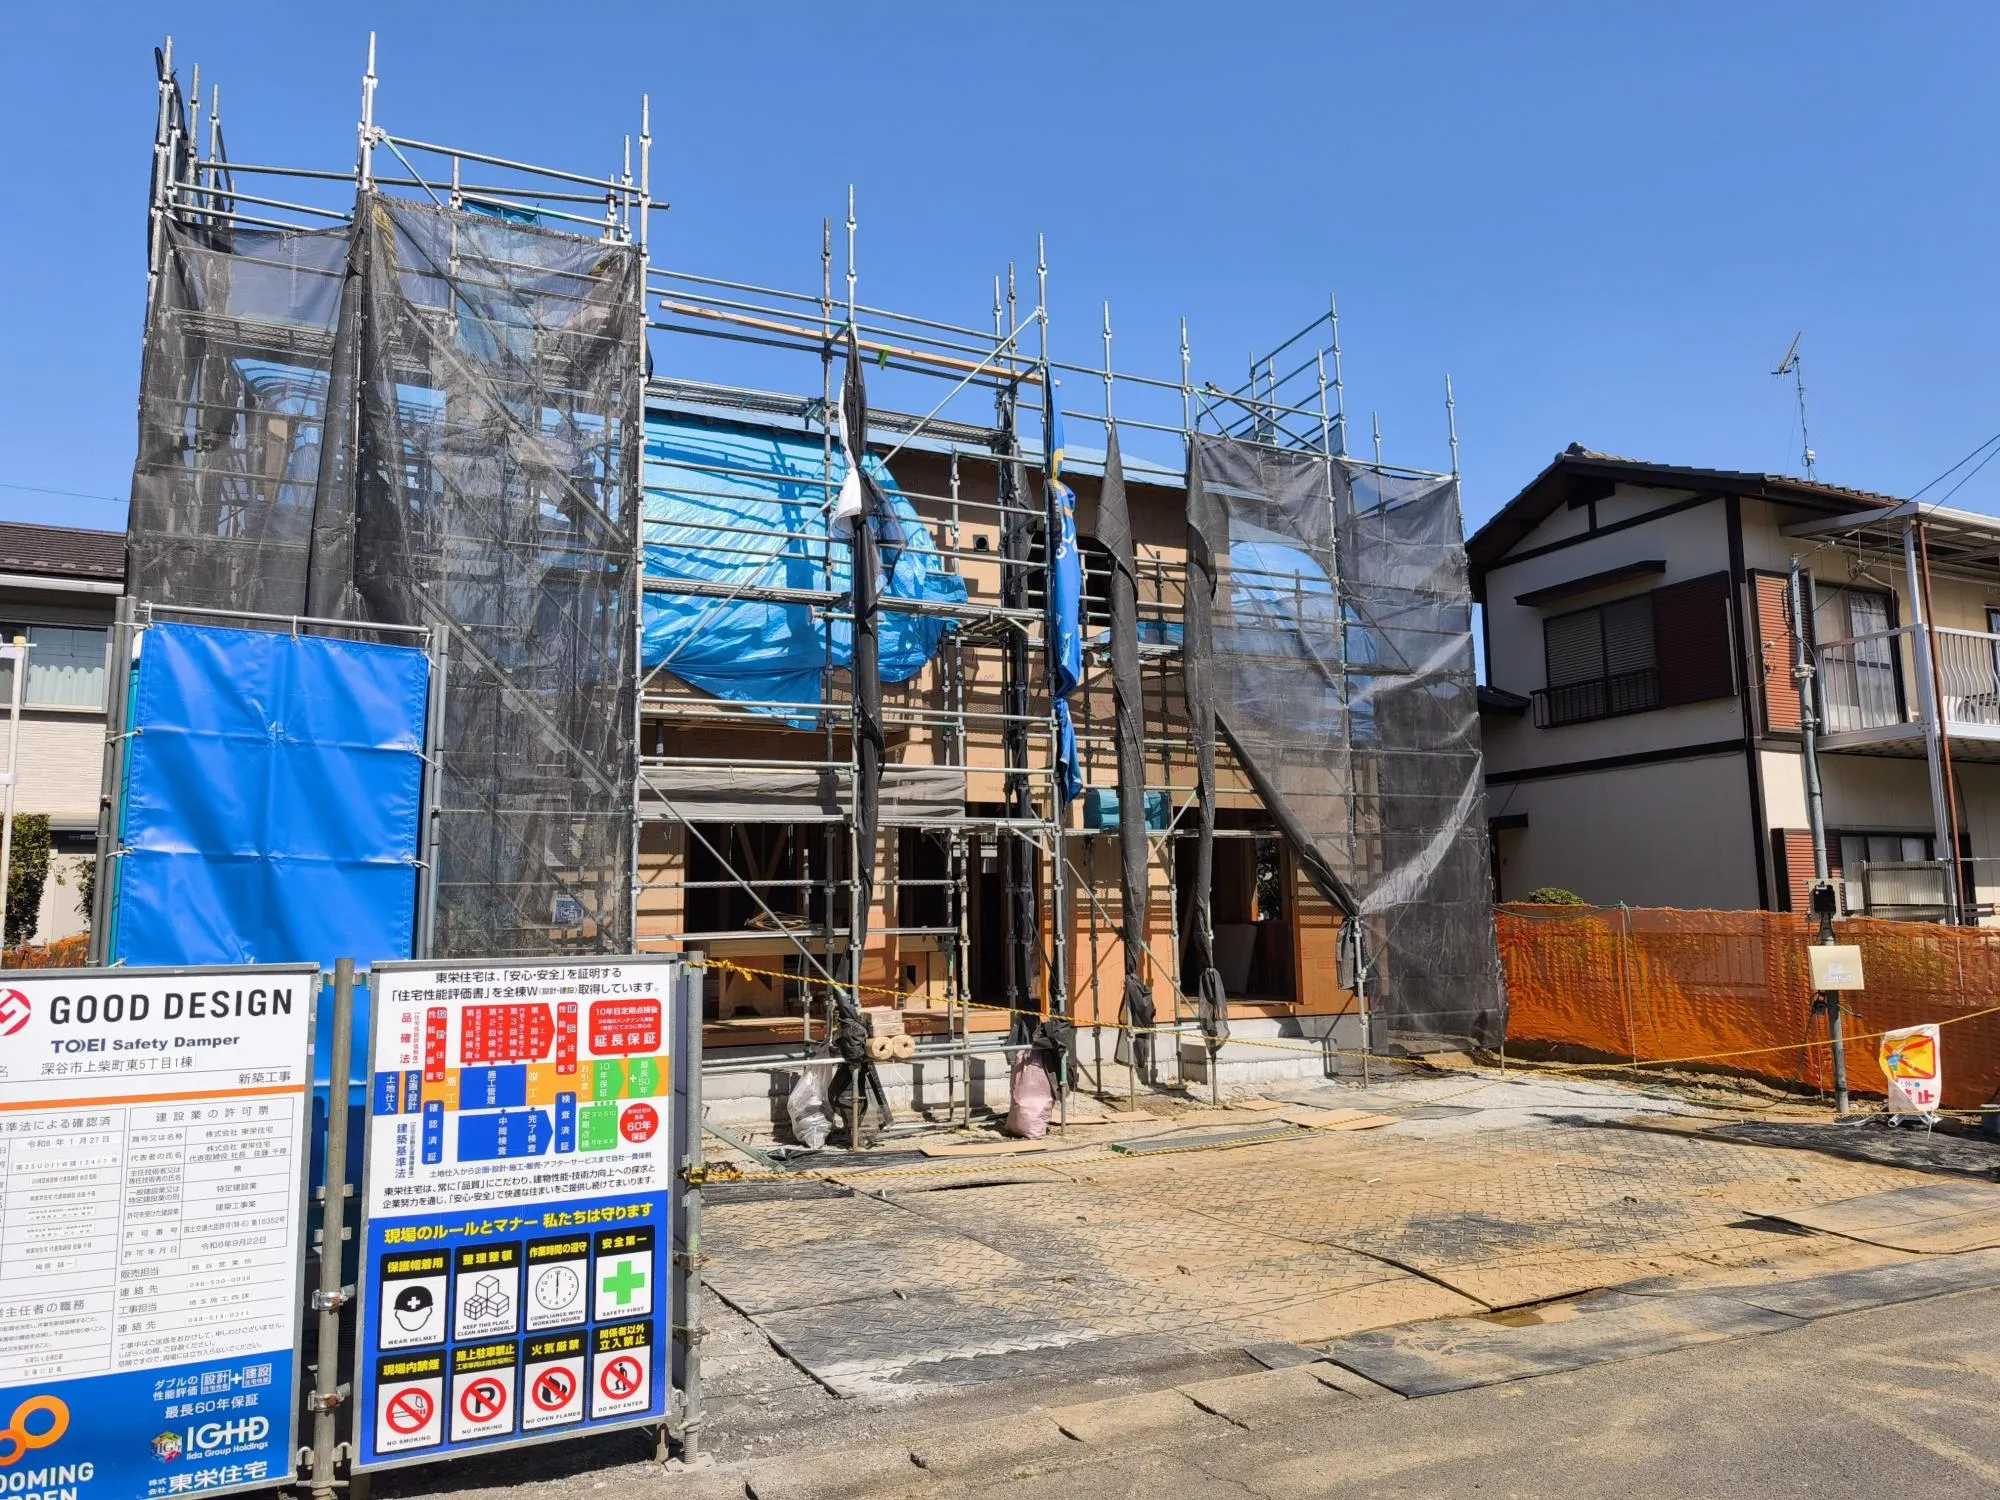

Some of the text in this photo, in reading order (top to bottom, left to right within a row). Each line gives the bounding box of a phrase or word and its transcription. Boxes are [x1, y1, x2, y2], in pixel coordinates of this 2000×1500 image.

[50, 988, 292, 1025] GOOD DESIGN
[400, 1012, 412, 1065] 品確法
[465, 1009, 476, 1059] 第1回検査
[487, 1008, 498, 1059] 第2回検査
[509, 1007, 519, 1058] 第3回検査
[530, 1006, 540, 1056] 第4回検査
[112, 1036, 168, 1051] Safety
[174, 1036, 240, 1049] Damper
[593, 1031, 657, 1049] 延長保証
[238, 1071, 291, 1085] 新築工事
[599, 1062, 611, 1098] 10年保証
[385, 1074, 397, 1113] 土地仕入
[486, 1070, 497, 1106] 施工管理
[155, 1105, 269, 1123] 建設業の許可票
[560, 1094, 572, 1152] 検査済証
[627, 1121, 652, 1132] 60年
[131, 1135, 184, 1144] 商号又は名称
[206, 1126, 274, 1139] 株式会社 東栄住宅
[427, 1103, 439, 1162] 確認済証
[497, 1116, 508, 1156] 中間検査
[527, 1114, 538, 1154] 完了検査
[631, 1131, 647, 1142] 保証
[206, 1140, 271, 1153] 株式会社 東栄住宅
[395, 1123, 408, 1179] 建築基準法
[130, 1151, 183, 1163] 代表者の氏名
[189, 1153, 228, 1164] 代表取締役
[231, 1151, 247, 1160] 社長
[129, 1185, 181, 1196] 一般建設業又は
[216, 1182, 257, 1193] 特定建設業
[128, 1193, 180, 1205] 特定建設業の別
[215, 1200, 257, 1212] 建築工事業
[384, 1202, 654, 1244] 現場のルールとマナー 私たちは守ります
[126, 1227, 179, 1240] 許可番号
[529, 1241, 587, 1258] 作業時間の遵守
[602, 1235, 647, 1250] 安全第一
[124, 1245, 178, 1259] 許可年月日
[462, 1249, 513, 1266] 整理整頓
[387, 1257, 444, 1273] 保護帽着用
[120, 1267, 160, 1280] 販売担当
[119, 1285, 159, 1298] 連絡先
[119, 1302, 158, 1316] 工事担当
[530, 1312, 568, 1321] COMPLIANCE
[602, 1309, 625, 1317] SAFETY
[117, 1321, 157, 1334] 連絡先
[490, 1325, 514, 1333] ORDERLY
[532, 1318, 560, 1327] WORKING
[409, 1335, 437, 1343] HELMET
[600, 1324, 645, 1340] 関係者以外
[532, 1339, 580, 1356] 火気厳禁
[600, 1334, 645, 1351] 立入禁止
[456, 1343, 515, 1362] 路上駐車禁止
[245, 1364, 271, 1379] 建設
[383, 1359, 440, 1376] 現場内禁煙
[154, 1376, 199, 1391] ダブルの
[203, 1371, 229, 1386] 設計
[153, 1386, 198, 1402] 性能評価
[165, 1393, 259, 1420] 最長60年保証
[623, 1400, 644, 1408] ENTER
[536, 1415, 555, 1423] OPEN
[555, 1411, 581, 1420] FLAMES
[187, 1416, 270, 1452] IGHD
[473, 1424, 503, 1433] PARKING
[399, 1435, 431, 1445] SMOKING
[204, 1448, 231, 1460] Group
[233, 1441, 270, 1454] Holdings
[148, 1477, 167, 1488] 株式
[168, 1460, 268, 1494] 東栄住宅
[148, 1486, 167, 1496] 会社
